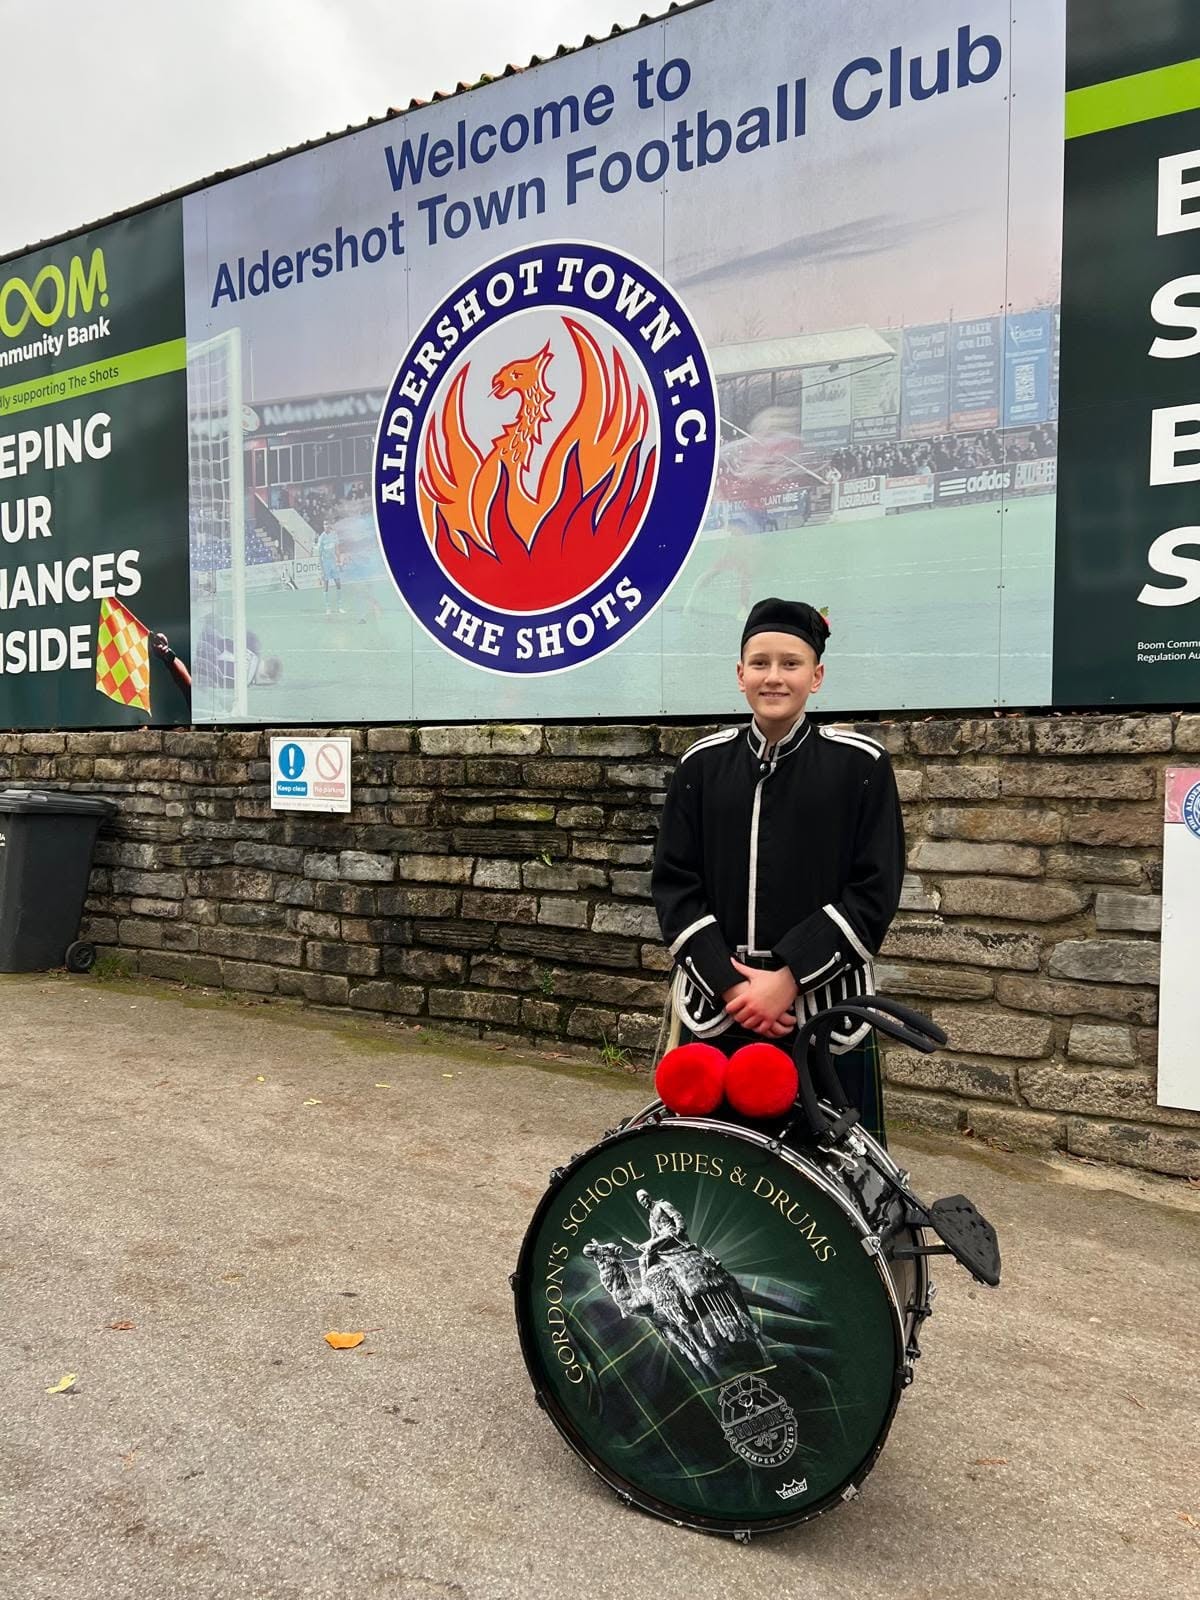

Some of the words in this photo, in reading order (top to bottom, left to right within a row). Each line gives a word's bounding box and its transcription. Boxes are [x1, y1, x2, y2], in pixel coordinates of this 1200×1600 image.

[384, 83, 615, 192] Welcome
[632, 57, 692, 110] to
[211, 212, 405, 308] Aldershot
[417, 177, 546, 246] Town
[566, 77, 807, 206] Football
[832, 24, 1003, 122] Club
[67, 315, 111, 348] Bank
[12, 380, 66, 405] supporting
[68, 374, 87, 390] The
[90, 366, 119, 384] Shots
[381, 259, 543, 506] ALDERSHOT
[557, 257, 681, 354] TOWN
[663, 355, 709, 464] F.C.
[0, 412, 112, 479] EPING
[966, 469, 1011, 493] adidas
[1, 495, 52, 543] UR
[434, 593, 505, 656] THE
[516, 575, 643, 660] SHOTS
[0, 624, 92, 675] SIDE
[1137, 641, 1165, 650] Boom
[1167, 640, 1200, 649] Comm
[1137, 652, 1187, 664] Regulation
[1188, 651, 1200, 660] Au
[277, 785, 292, 793] Keep
[655, 1152, 724, 1178] PIPES
[729, 1166, 748, 1186] &
[562, 1161, 645, 1236] SCHOOL
[752, 1176, 838, 1263] DRUMS
[545, 1241, 585, 1384] GORDON'S
[740, 1446, 776, 1465] SEMPER
[778, 1426, 794, 1460] FIDELIS
[782, 1484, 806, 1497] REMO
